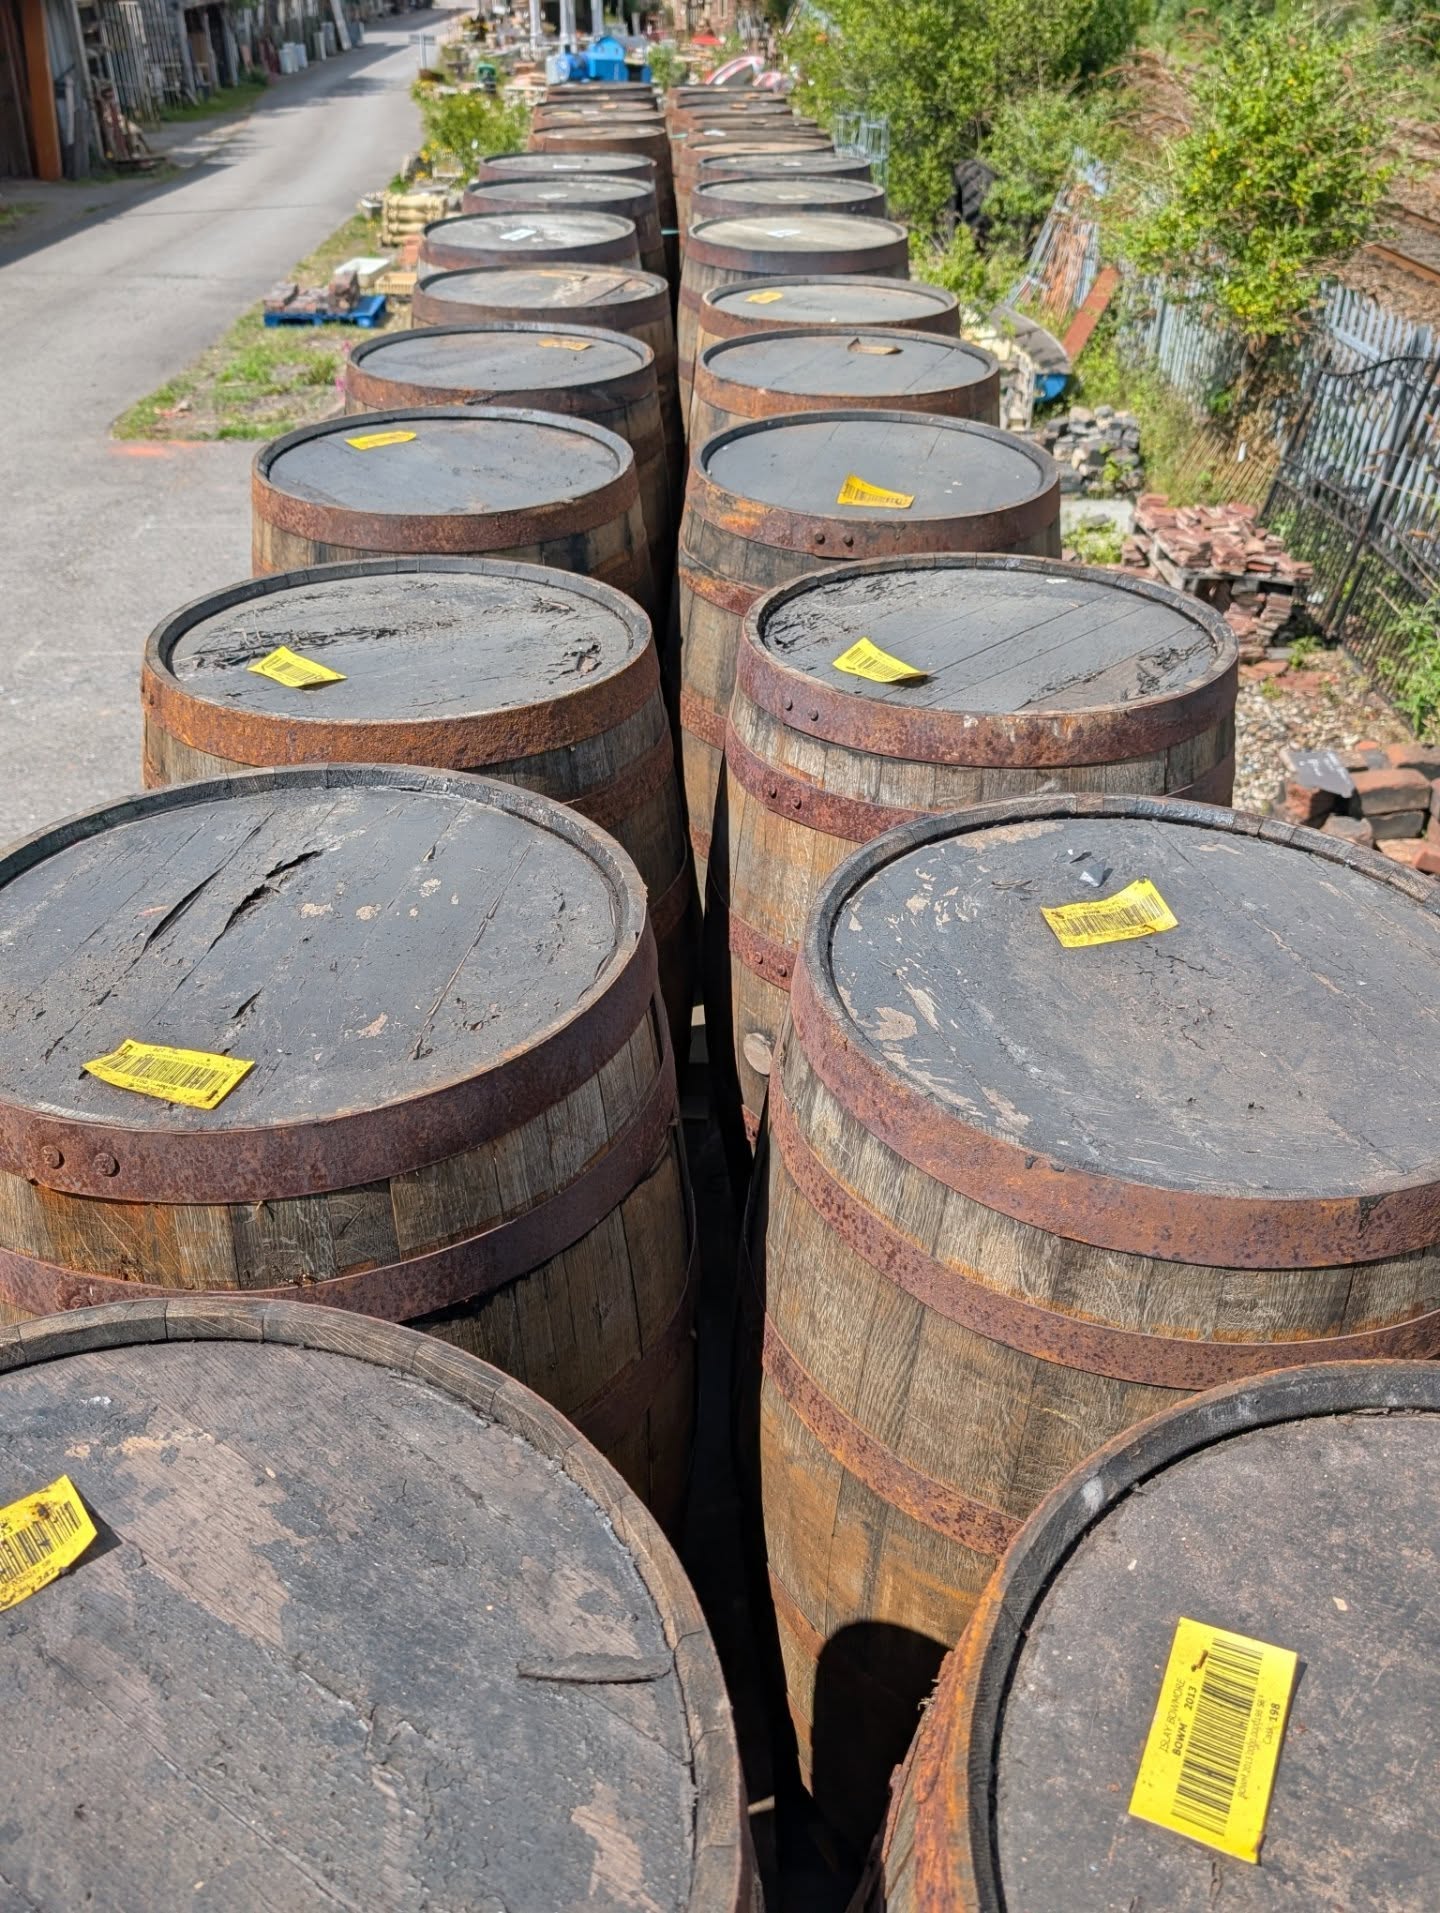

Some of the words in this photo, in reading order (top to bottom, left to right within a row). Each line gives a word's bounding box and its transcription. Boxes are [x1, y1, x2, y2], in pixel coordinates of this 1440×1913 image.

[1159, 1724, 1173, 1753] ISLAY
[1167, 1678, 1185, 1725] BOWMORE
[1172, 1722, 1188, 1756] BOWM
[1184, 1685, 1197, 1711] 2013
[1269, 1702, 1281, 1722] 198
